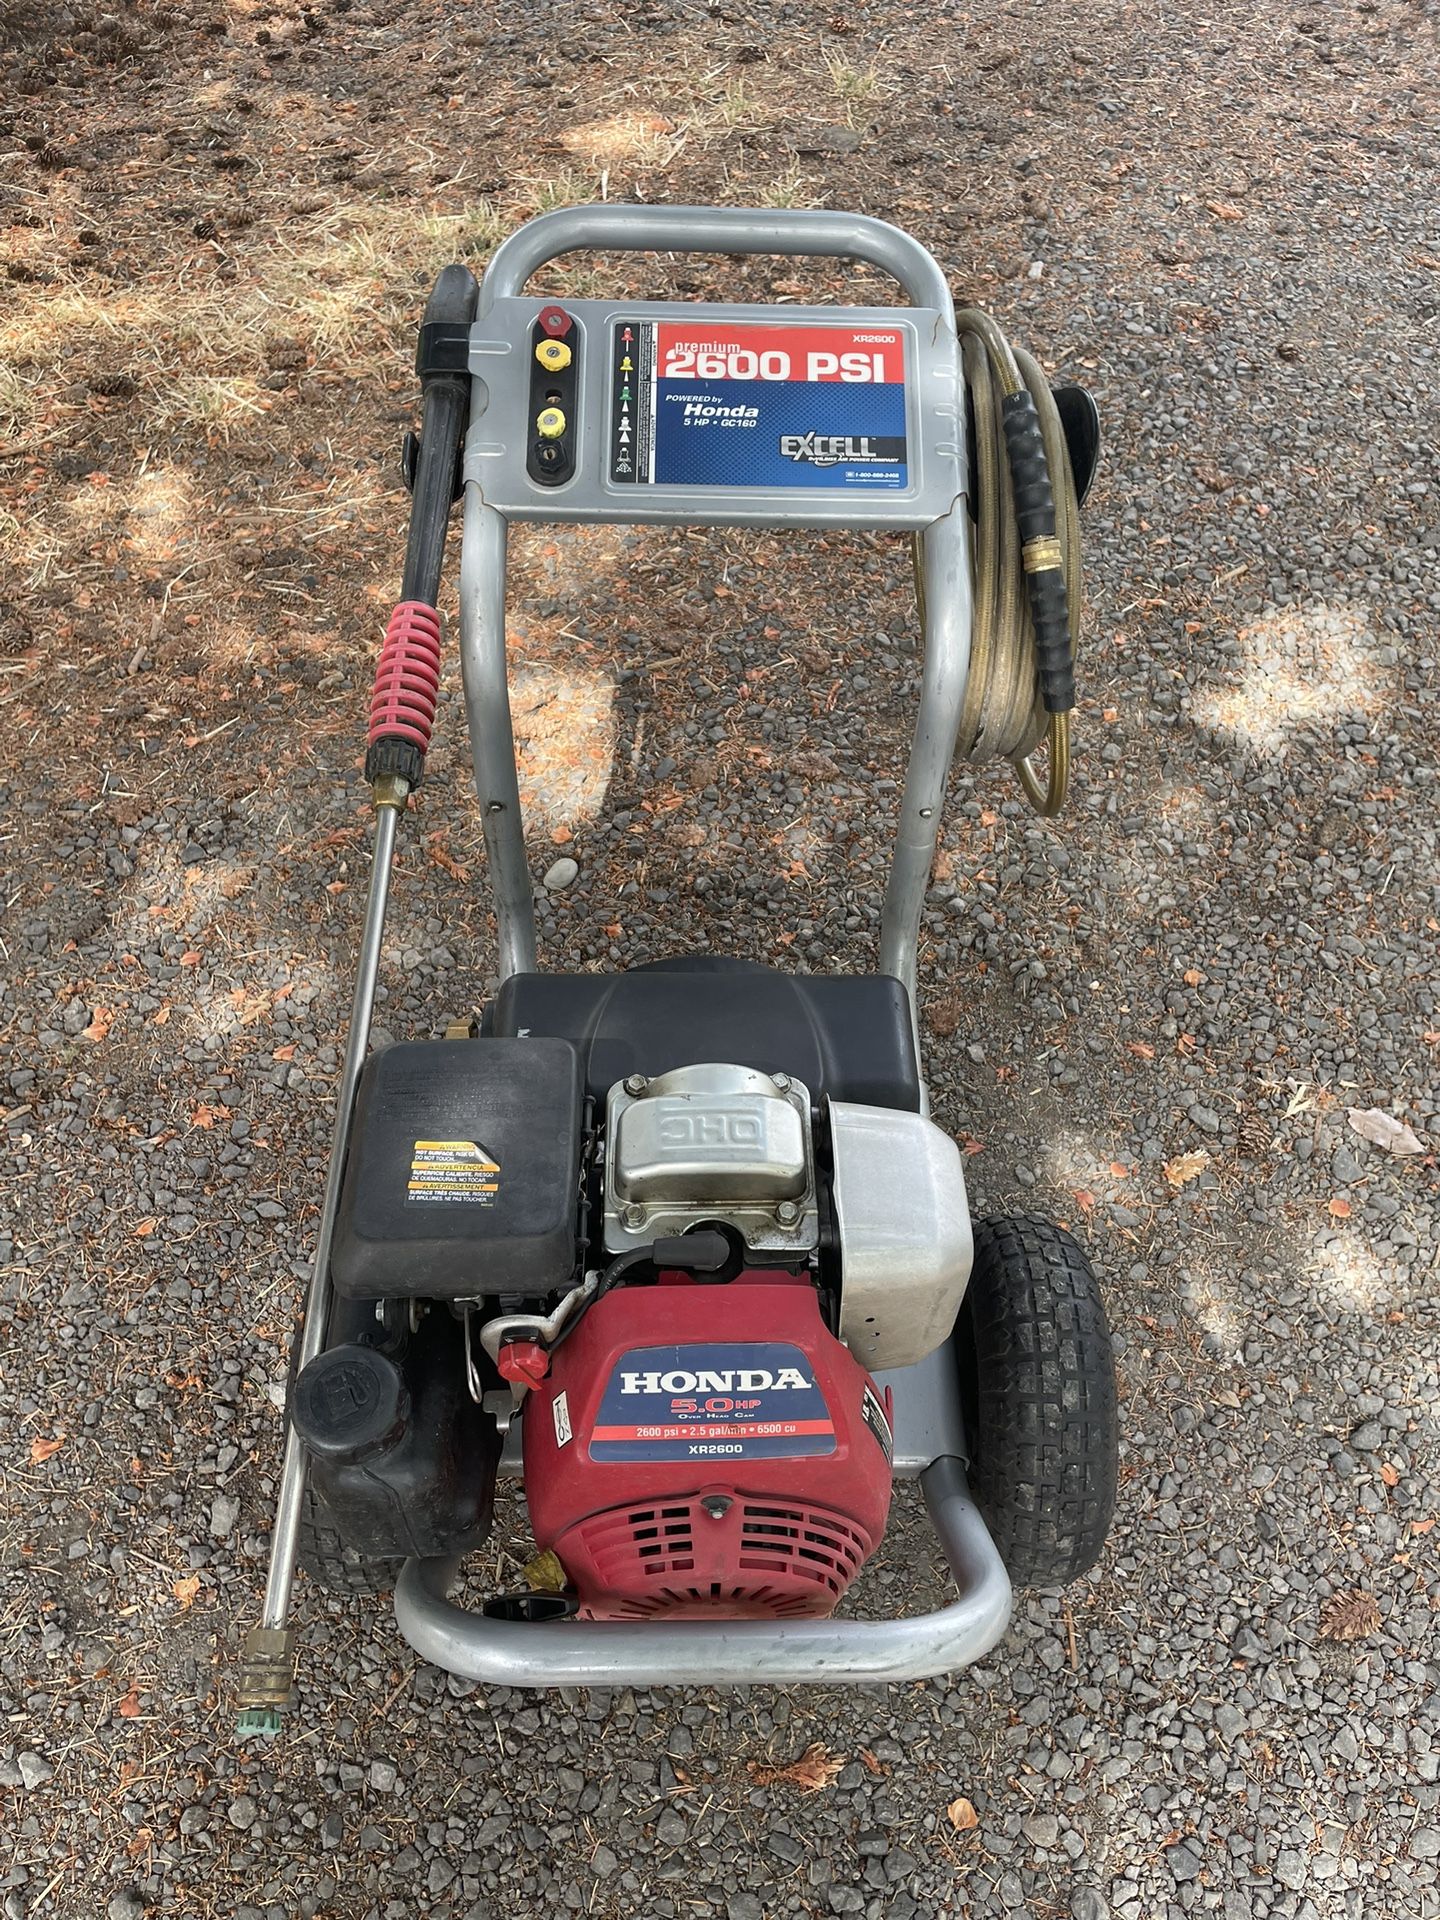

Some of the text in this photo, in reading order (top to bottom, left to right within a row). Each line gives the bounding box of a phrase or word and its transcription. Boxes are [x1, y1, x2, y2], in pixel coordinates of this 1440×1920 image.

[853, 334, 896, 343] XR2600
[674, 341, 741, 354] premium
[665, 350, 791, 381] 2600
[807, 352, 885, 384] PSI
[665, 394, 711, 402] POWERED
[683, 403, 759, 417] Honda
[683, 418, 757, 427] 5 HP GC160
[620, 1368, 812, 1394] HONDA
[636, 1427, 662, 1437] 2600
[664, 1427, 679, 1438] psi
[690, 1426, 706, 1436] 2.5
[757, 1424, 782, 1434] 6500
[784, 1425, 796, 1433] cu
[689, 1444, 743, 1454] XR2600
